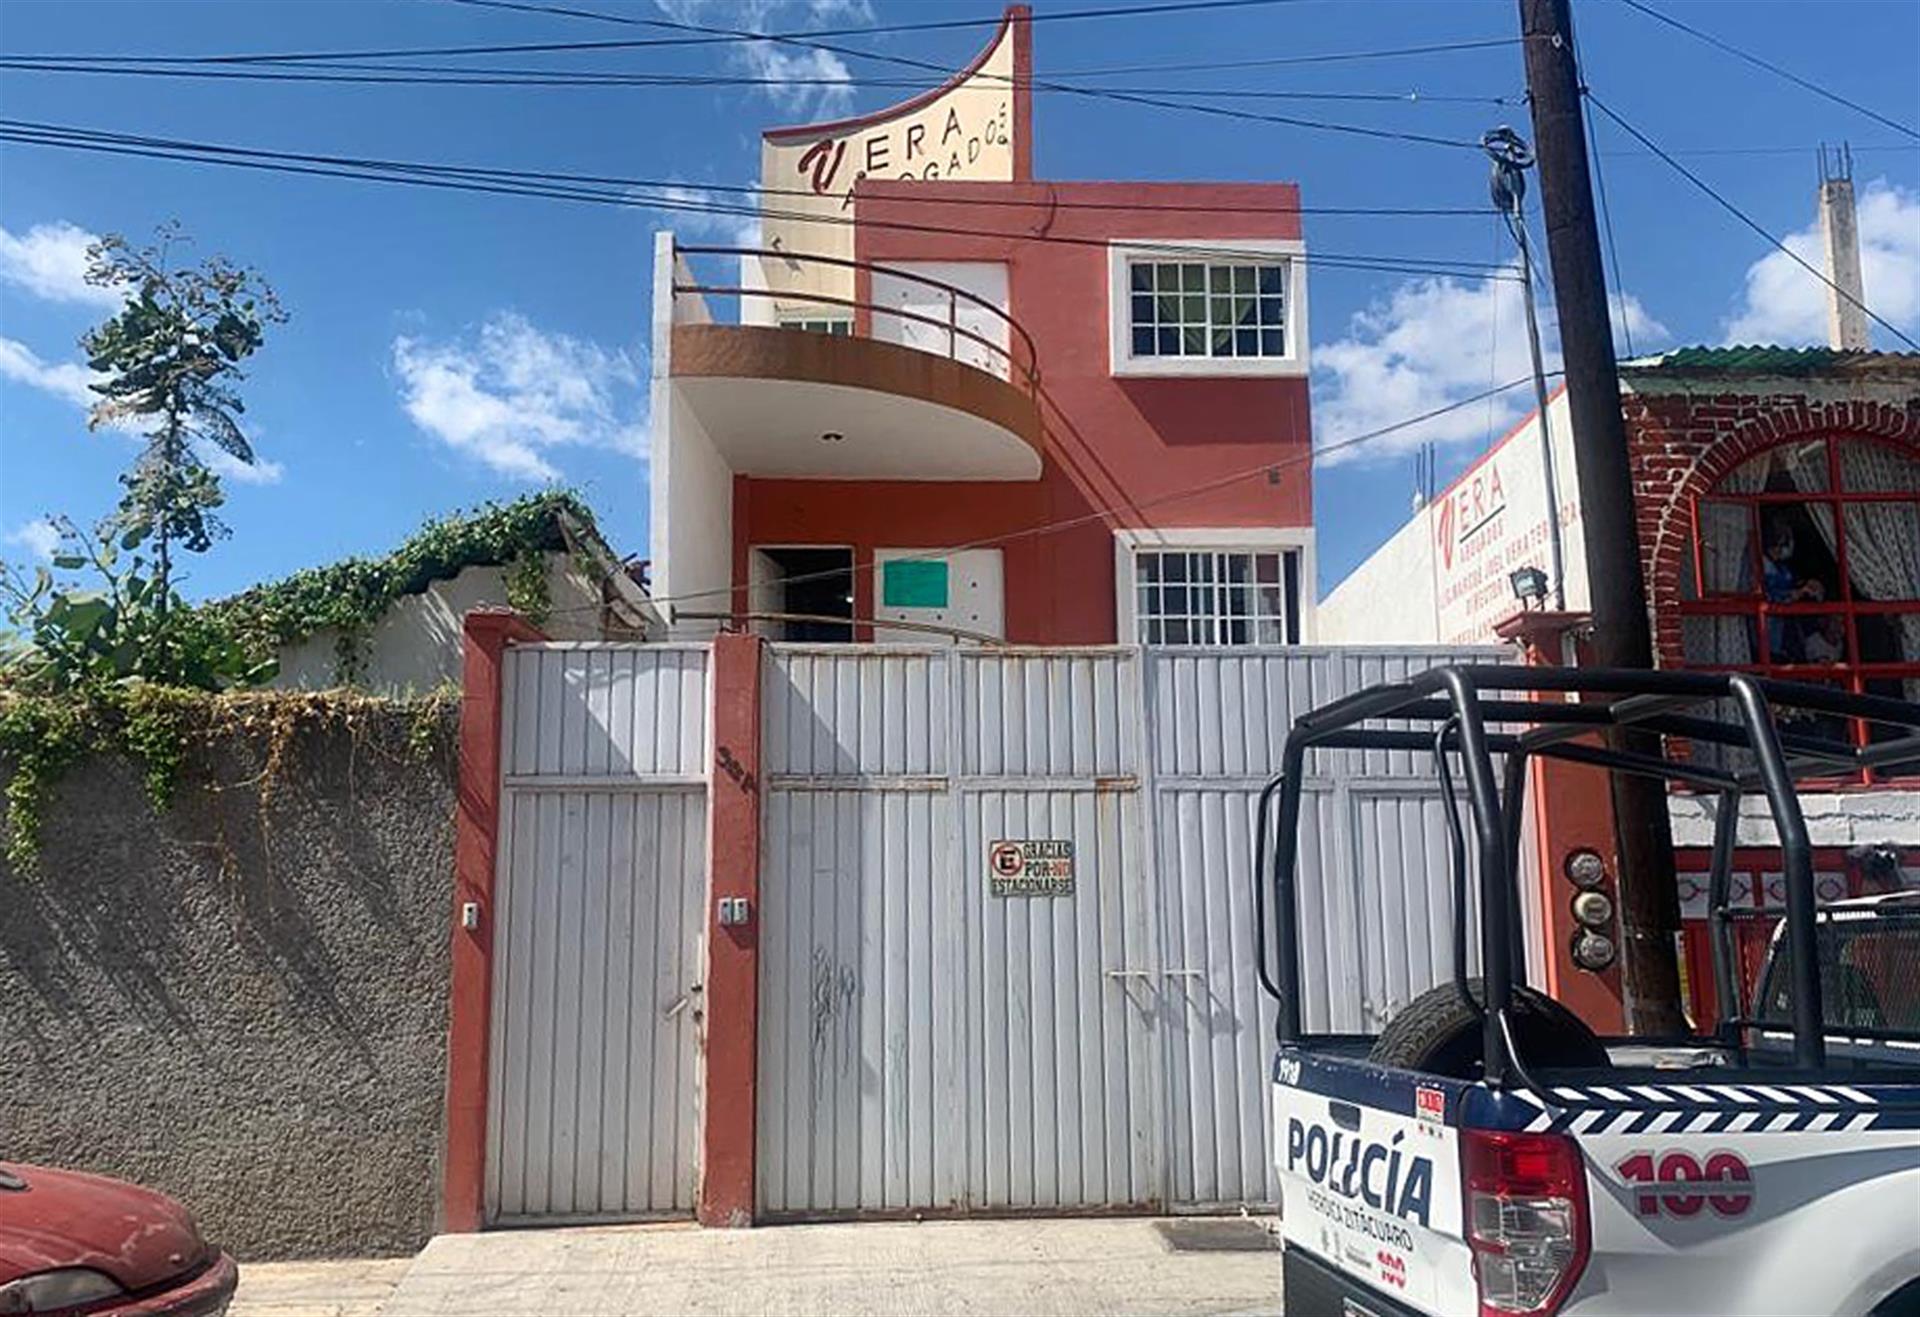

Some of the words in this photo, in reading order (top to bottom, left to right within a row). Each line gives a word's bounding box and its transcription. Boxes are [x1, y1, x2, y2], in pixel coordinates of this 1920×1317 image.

[798, 106, 963, 195] VERA
[1438, 461, 1505, 570] VERA
[991, 878, 1073, 895] ESTACIONARSE
[1024, 842, 1073, 860] GRACIAS
[1288, 1117, 1434, 1229] POLICÍA
[1614, 1150, 1755, 1218] 100
